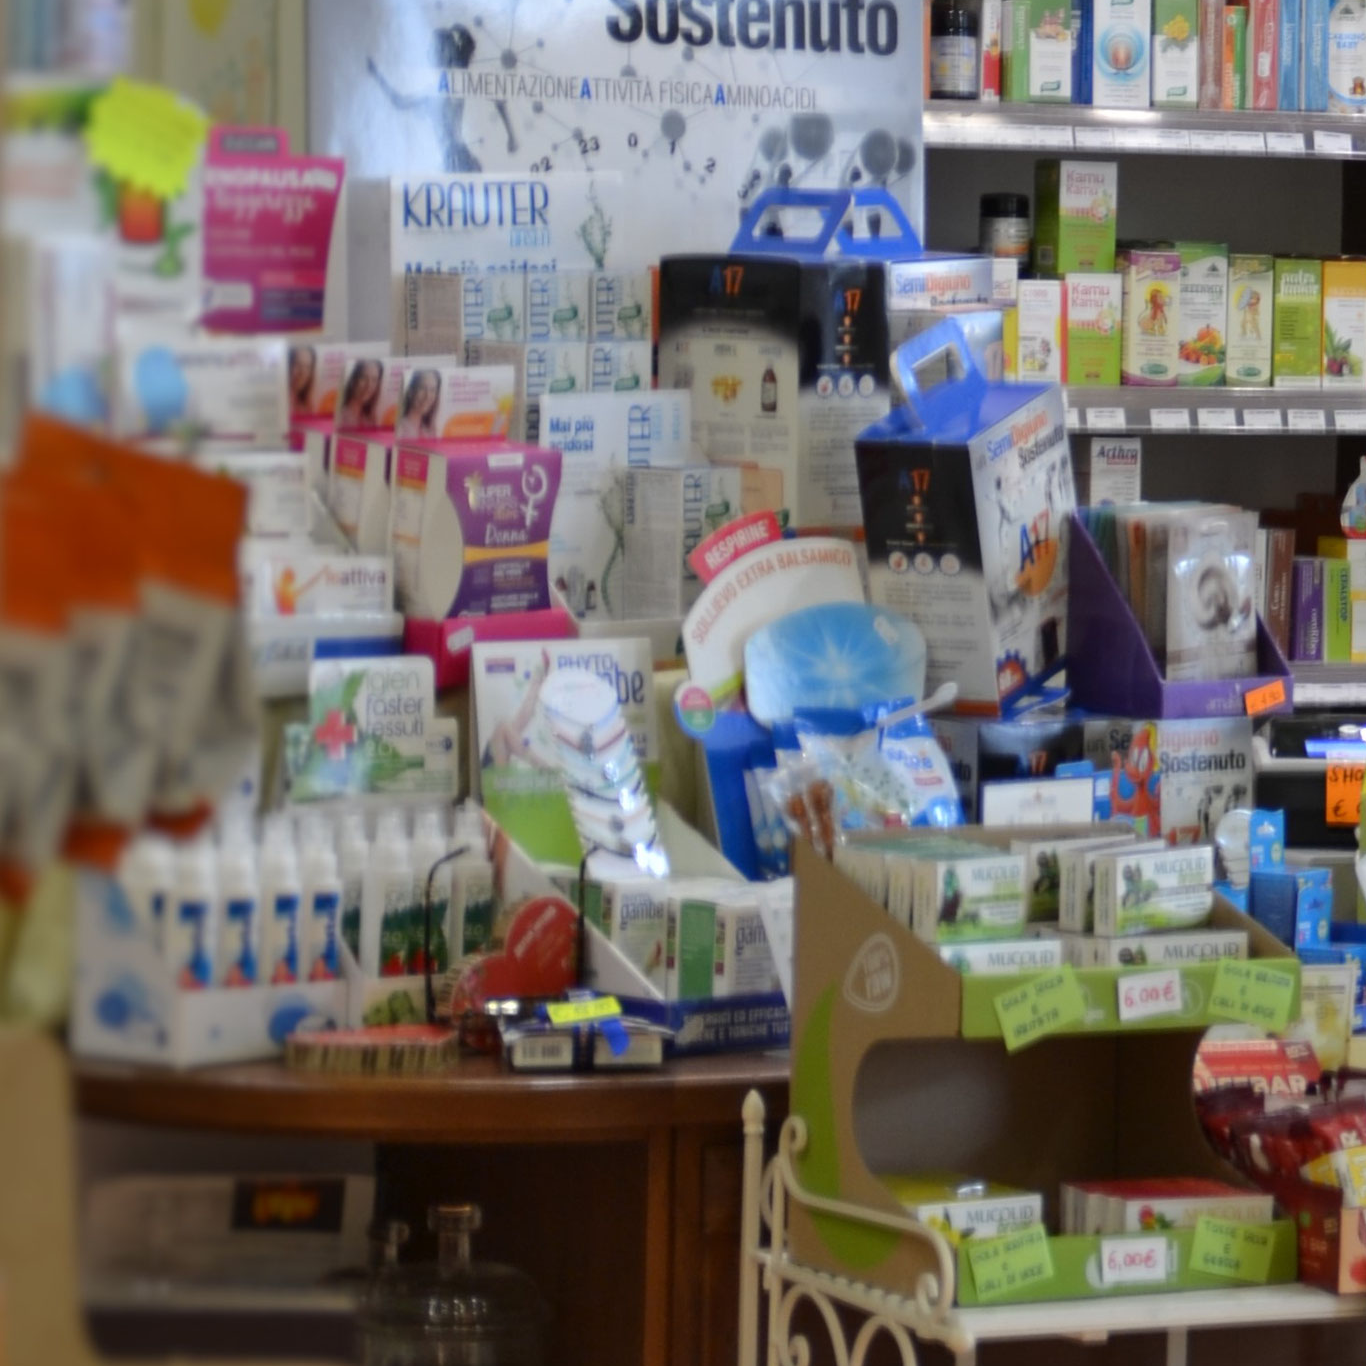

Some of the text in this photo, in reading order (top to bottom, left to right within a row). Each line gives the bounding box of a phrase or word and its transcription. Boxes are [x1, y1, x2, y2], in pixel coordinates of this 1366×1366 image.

[776, 548, 852, 571] BALSAMICO
[1159, 749, 1246, 775] Sostenuto
[735, 924, 769, 957] gam
[1163, 940, 1240, 960] MUCOLID
[966, 1205, 1035, 1225] MUCOLID
